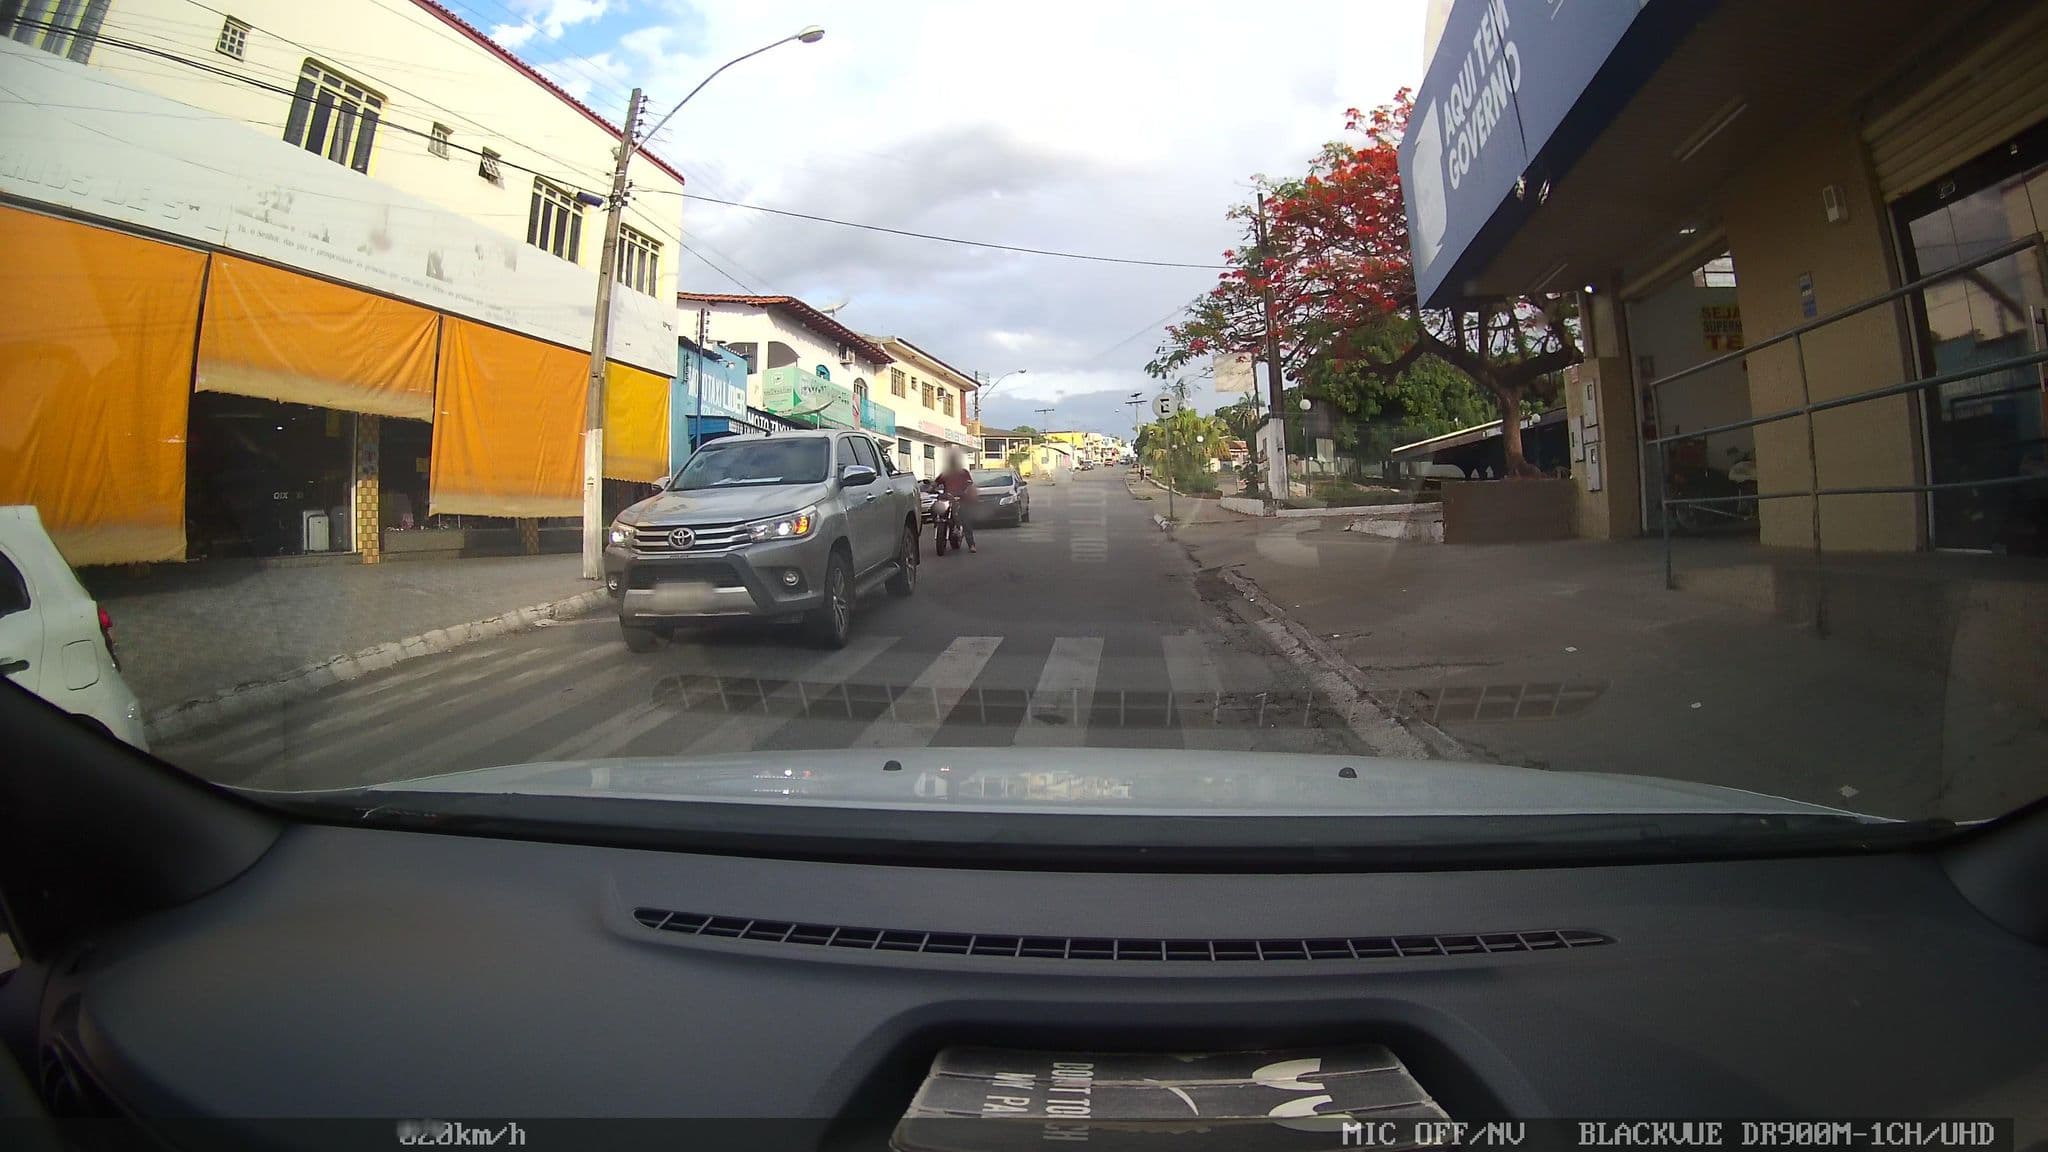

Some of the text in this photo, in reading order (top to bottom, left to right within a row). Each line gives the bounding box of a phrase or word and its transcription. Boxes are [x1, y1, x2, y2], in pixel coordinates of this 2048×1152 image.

[1443, 0, 1509, 147] AQUI TEM
[1448, 41, 1521, 190] GOVERNO
[688, 366, 722, 408] MOOTAXI
[748, 411, 769, 430] MOTO
